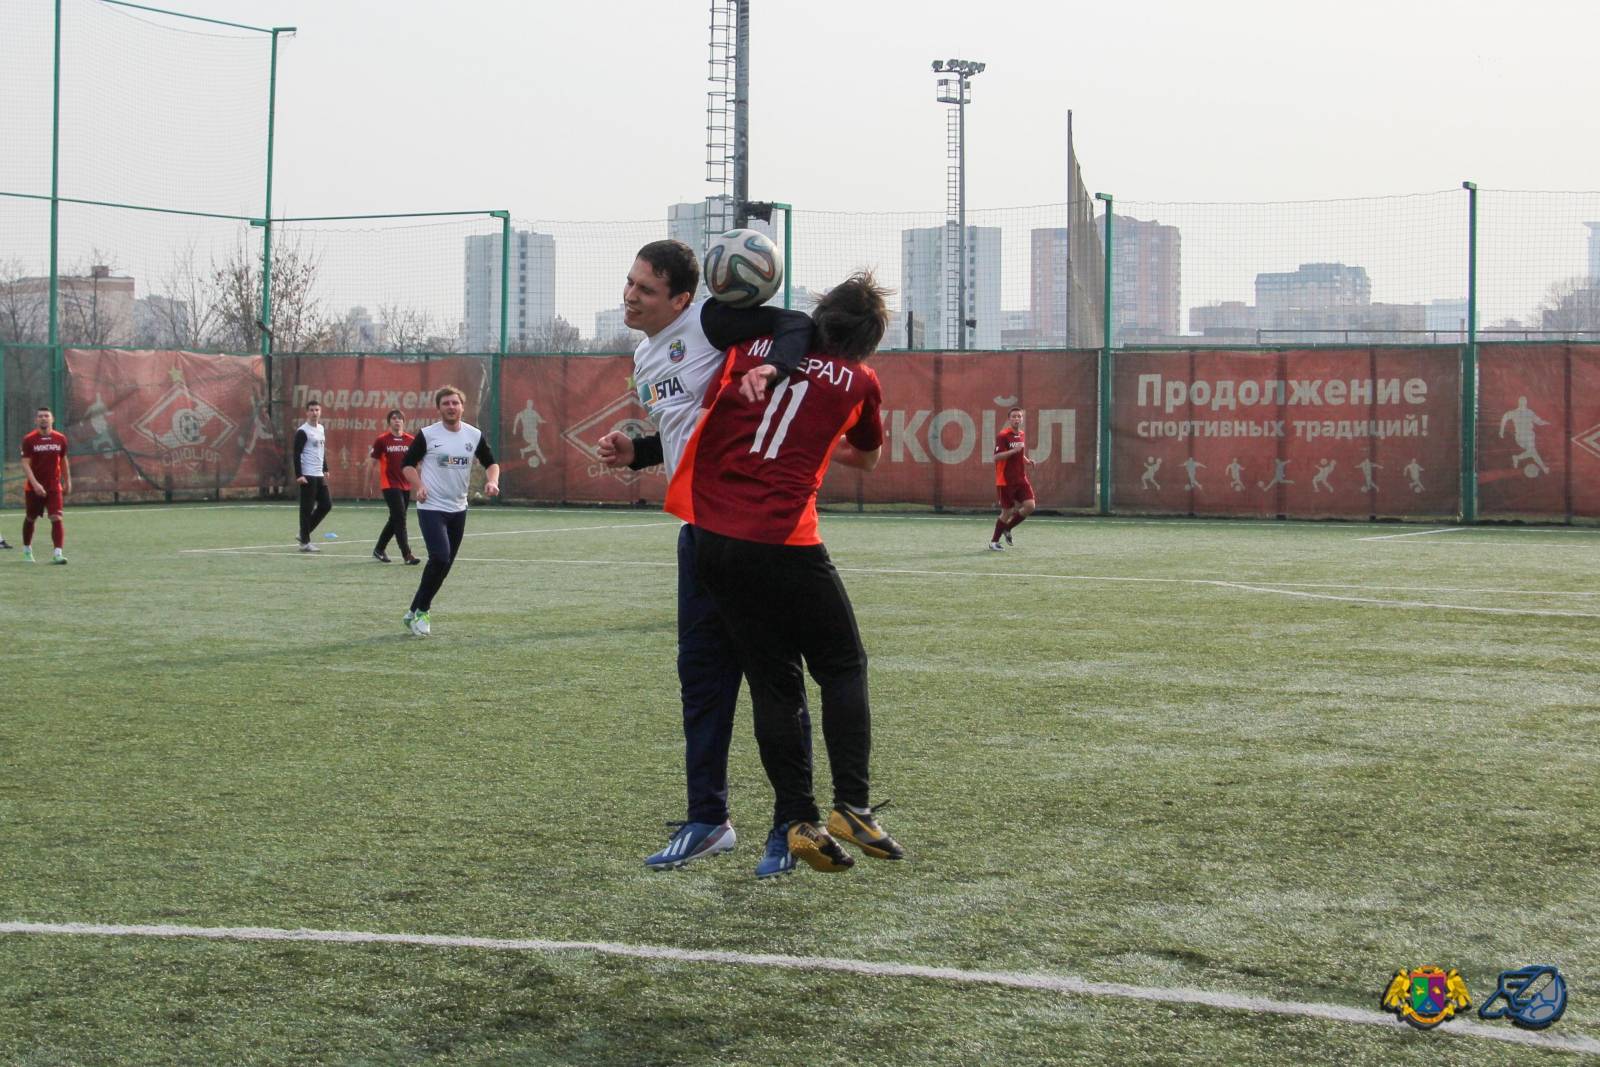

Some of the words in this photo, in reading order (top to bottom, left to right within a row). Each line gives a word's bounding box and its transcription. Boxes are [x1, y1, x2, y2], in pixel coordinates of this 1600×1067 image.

[747, 339, 854, 392] МЕРАЛ
[291, 384, 438, 412] Продолжен
[655, 376, 685, 401] БПА
[1137, 373, 1428, 414] Продолжение
[749, 376, 810, 460] 11
[880, 395, 1076, 464] КОЙЛ
[1137, 420, 1286, 441] спортивных
[1292, 414, 1429, 442] традиций!
